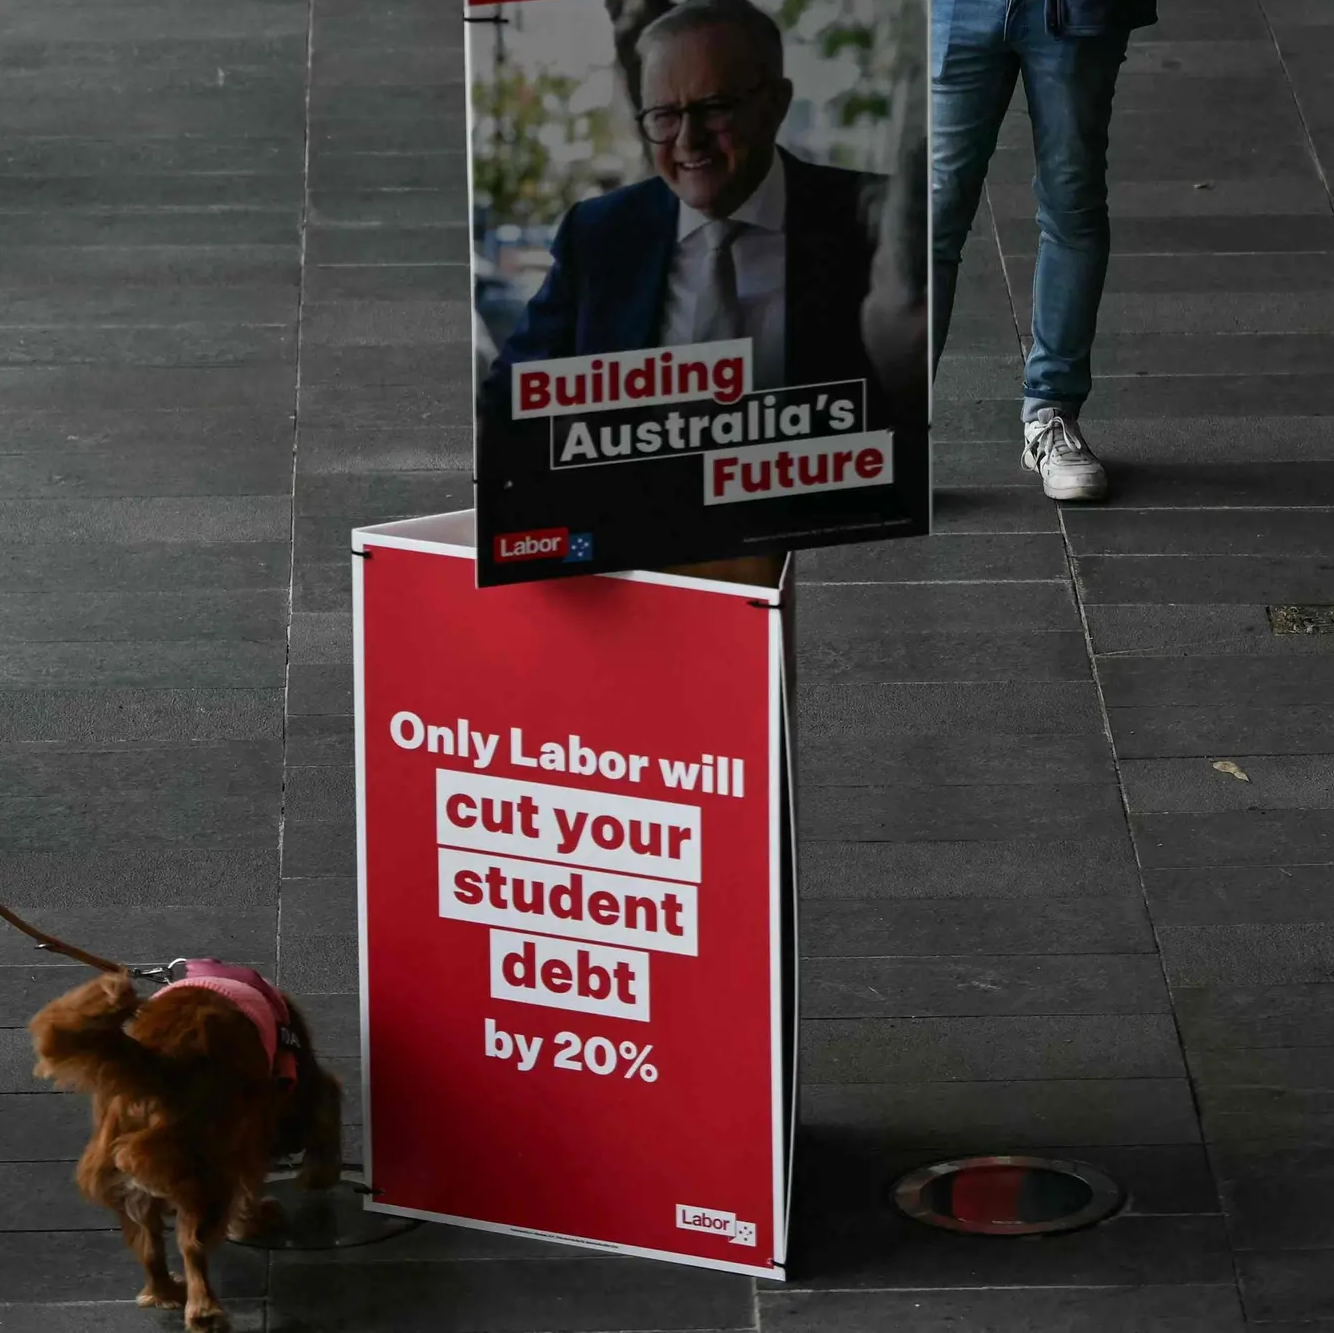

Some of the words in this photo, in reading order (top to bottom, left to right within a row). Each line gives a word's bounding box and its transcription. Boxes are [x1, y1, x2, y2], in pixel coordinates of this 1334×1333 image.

[519, 352, 744, 404] Building
[560, 394, 854, 461] Australia's
[713, 446, 884, 497] Future
[500, 536, 561, 557] Labor
[389, 711, 500, 768] Only
[511, 728, 648, 782] Labor
[658, 755, 745, 798] will
[446, 791, 539, 838] cut
[553, 806, 691, 860] your
[453, 867, 684, 936] student
[502, 941, 637, 1004] debt
[484, 1018, 543, 1072] by
[554, 1031, 658, 1083] 20%
[682, 1210, 731, 1231] Labor
